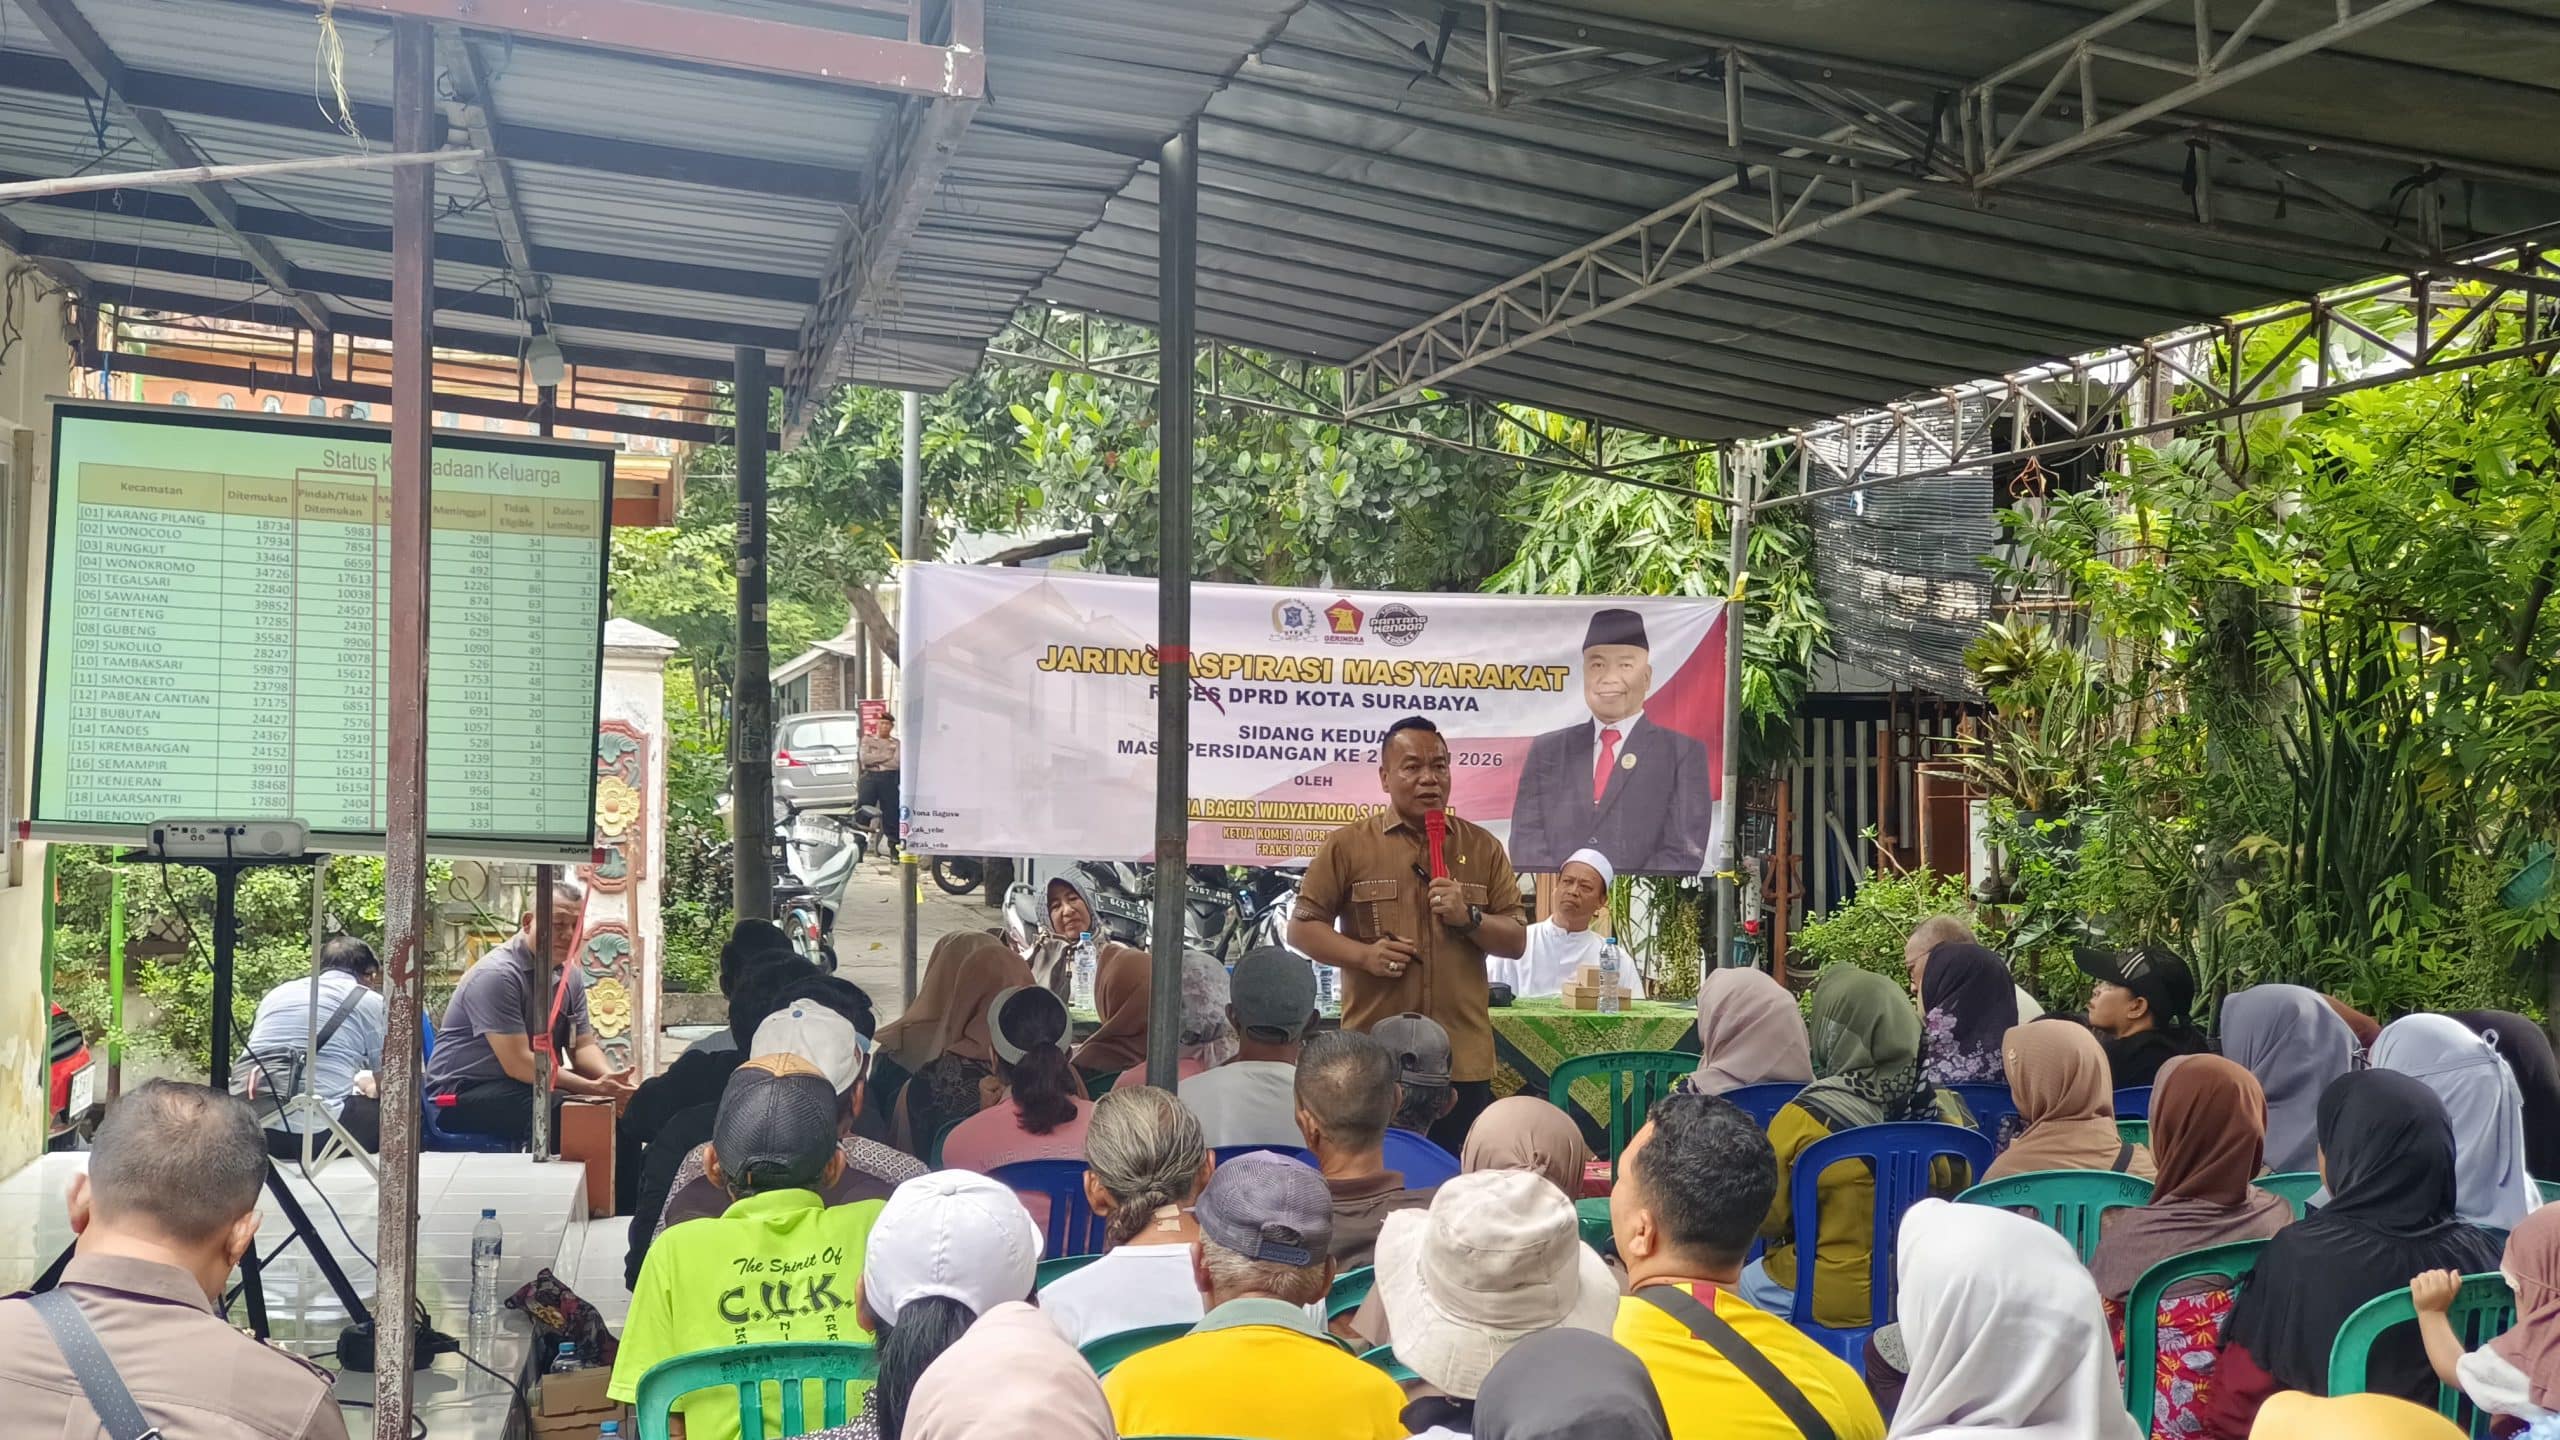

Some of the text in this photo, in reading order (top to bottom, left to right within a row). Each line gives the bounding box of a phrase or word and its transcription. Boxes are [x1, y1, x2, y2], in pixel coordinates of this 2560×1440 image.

[323, 449, 377, 471] Status
[488, 462, 560, 488] Keluarga
[121, 482, 183, 496] Kecamatan
[228, 490, 288, 503] Ditemukan
[304, 504, 362, 517] Ditemukan
[80, 508, 489, 545] [01] KARANG PILANG 18734 5983 298
[80, 523, 489, 559] [02] WONOCOLO 17934 7854 404
[79, 539, 489, 575] [03] RUNGKUT 33464 6659 492
[79, 556, 489, 590] [04] WONOKROMO 34726 17613 1226
[79, 573, 489, 606] [05] TEGALSARI 22840 10038 874
[78, 589, 489, 622] [06] SAWAHAN 39852 24507 1526
[77, 606, 489, 637] [07] GENTENG 17285 2430 629
[76, 623, 489, 653] [08] GUBENG 35582 9906 1090
[76, 639, 489, 669] [09] SUKOLILO 28247 10078 526
[75, 655, 489, 684] [10] TAMBAKSARI 59879 15612 1753
[1037, 645, 1159, 676] JARING
[1343, 660, 1569, 691] MASYARAKAT
[74, 673, 488, 700] [11] SIMOKERTO 23798 7142 1011
[1149, 684, 1479, 712] RES DPRD KOTA SURABAYA
[74, 689, 489, 716] [12] PABEAN CANTIAN 17175 6851 691
[73, 707, 489, 732] [13] BUBUTAN 24427 7576 1057
[73, 723, 489, 748] [14] TANDES 24367 5919 528
[1238, 725, 1314, 741] SIDANG
[72, 740, 95, 751] [15]
[100, 741, 189, 753] KREMBANGAN
[251, 747, 287, 757] 24152
[336, 750, 369, 760] 12541
[464, 754, 489, 763] 1239
[1117, 740, 1159, 755] MAS
[1334, 749, 1360, 762] KE
[1459, 753, 1502, 766] 2026
[71, 757, 94, 768] [16]
[98, 759, 167, 770] SEMAMPIR
[251, 764, 287, 774] 39910
[336, 767, 369, 776] 16143
[464, 770, 489, 780] 1923
[1294, 775, 1333, 787] OLEH
[70, 775, 93, 786] [17]
[97, 776, 162, 787] KENJERAN
[251, 780, 286, 790] 38468
[336, 783, 369, 792] 16154
[469, 786, 489, 796] 956
[69, 792, 489, 811] [18] LAKARSANTRI 17880 2404 184
[1205, 799, 1256, 818] BAGUS
[68, 809, 489, 827] [19] BENOWO 4964 333
[1223, 827, 1331, 841] KETUA KOMISI A DPR
[1256, 843, 1320, 857] FRAKSI PART
[733, 1247, 842, 1275] The Spirit Of
